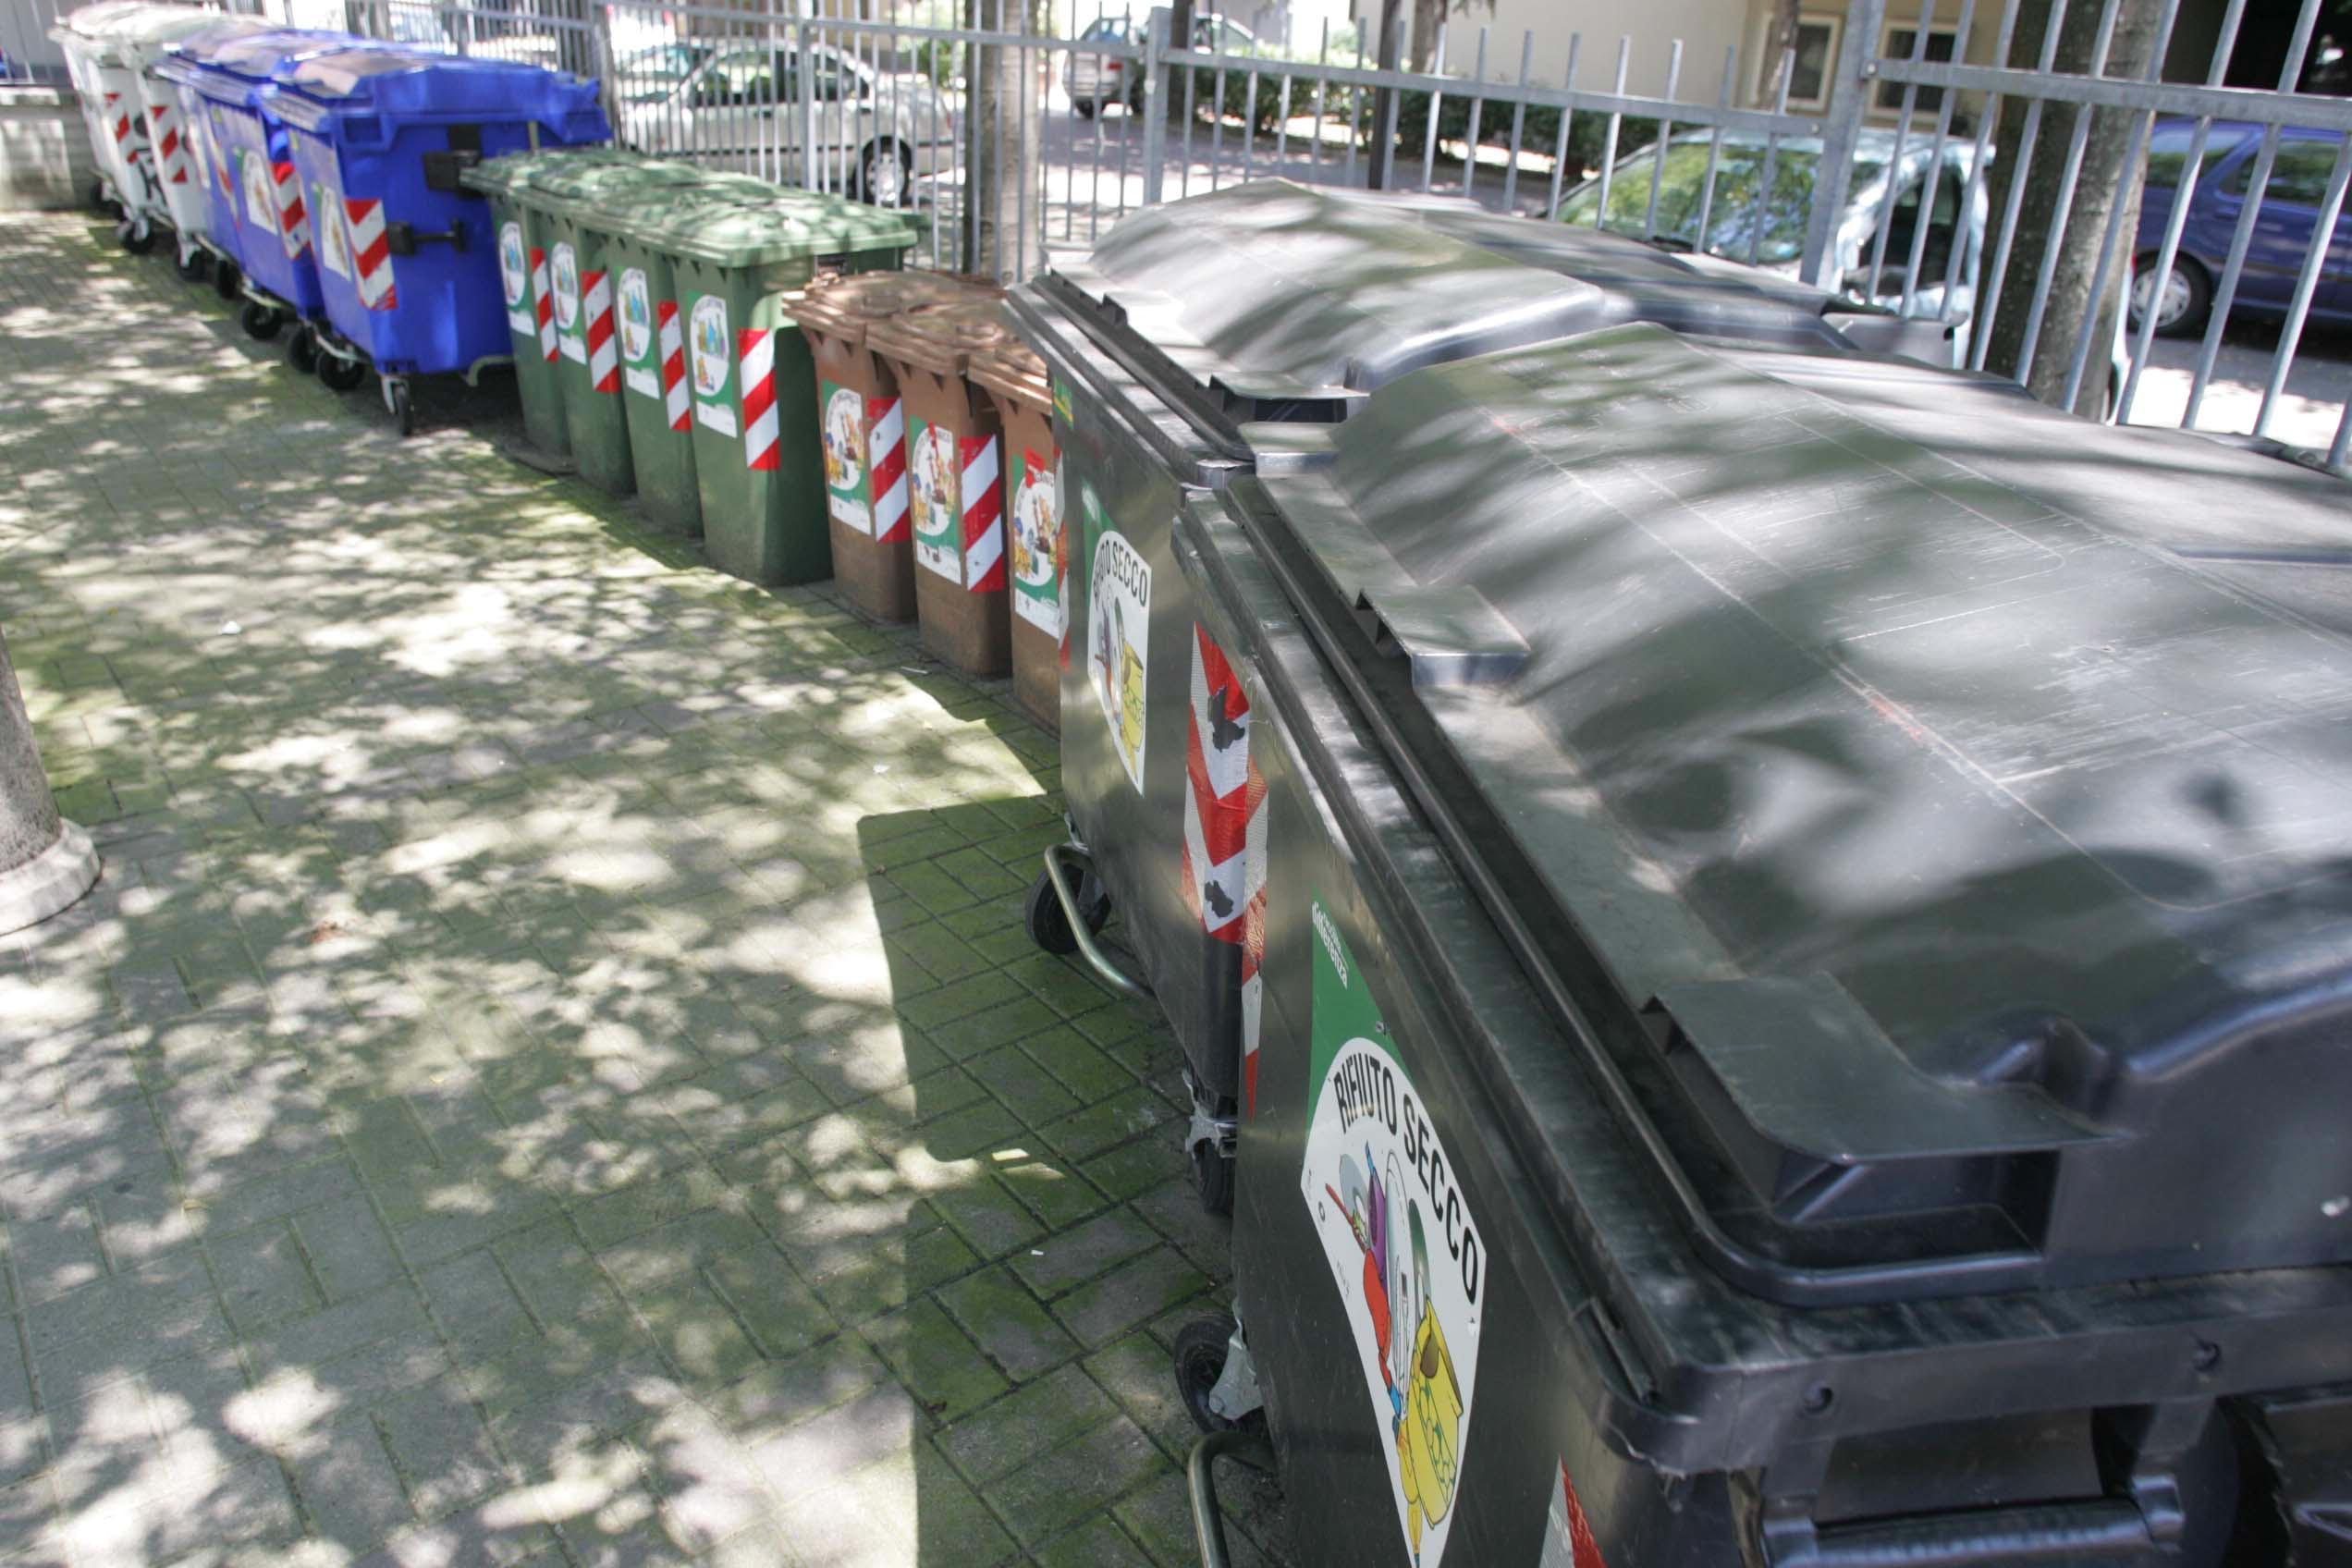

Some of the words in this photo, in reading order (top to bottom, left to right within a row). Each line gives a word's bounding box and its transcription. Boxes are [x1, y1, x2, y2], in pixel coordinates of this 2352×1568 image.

[1112, 540, 1148, 607] SECCO
[1333, 1052, 1398, 1136] RIFIUTO
[1403, 1093, 1479, 1305] SECCO
